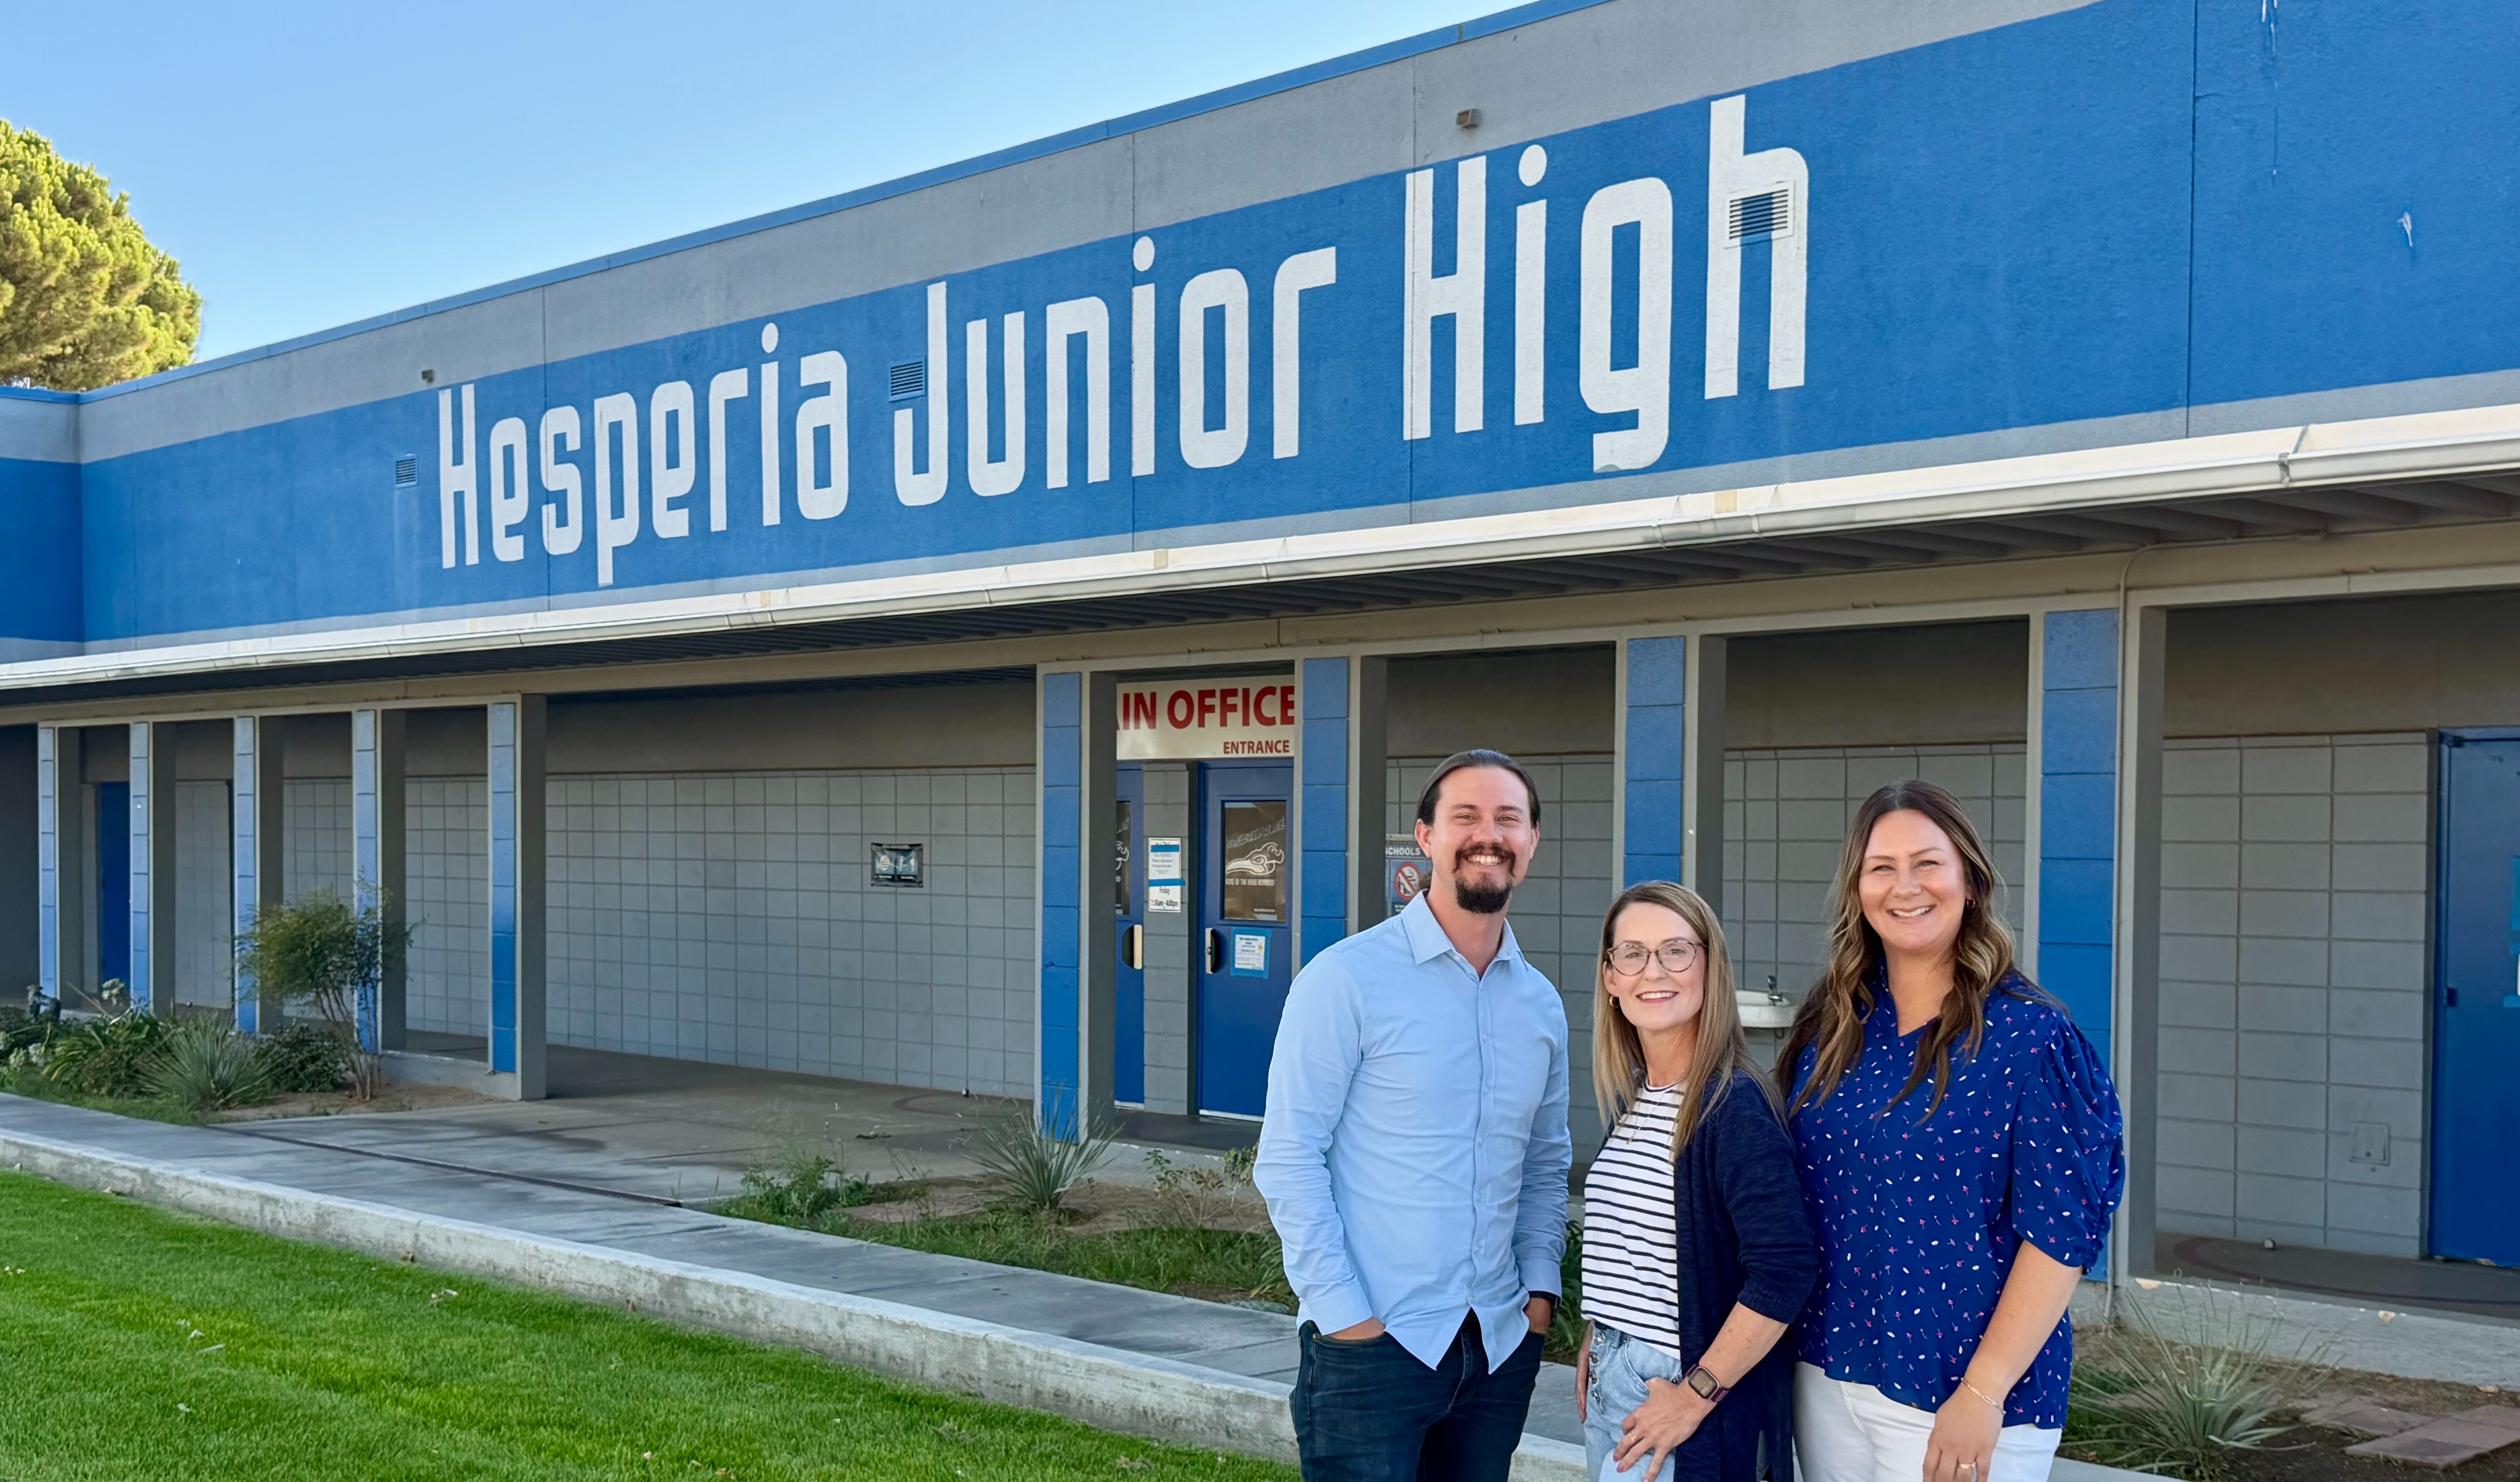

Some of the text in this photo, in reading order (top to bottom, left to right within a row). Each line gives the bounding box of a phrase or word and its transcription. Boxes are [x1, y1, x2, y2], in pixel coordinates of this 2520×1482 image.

[439, 94, 1808, 587] Hesperia Junior High
[1117, 686, 1295, 730] IN OFFICE
[1223, 740, 1290, 755] ENTRANCE
